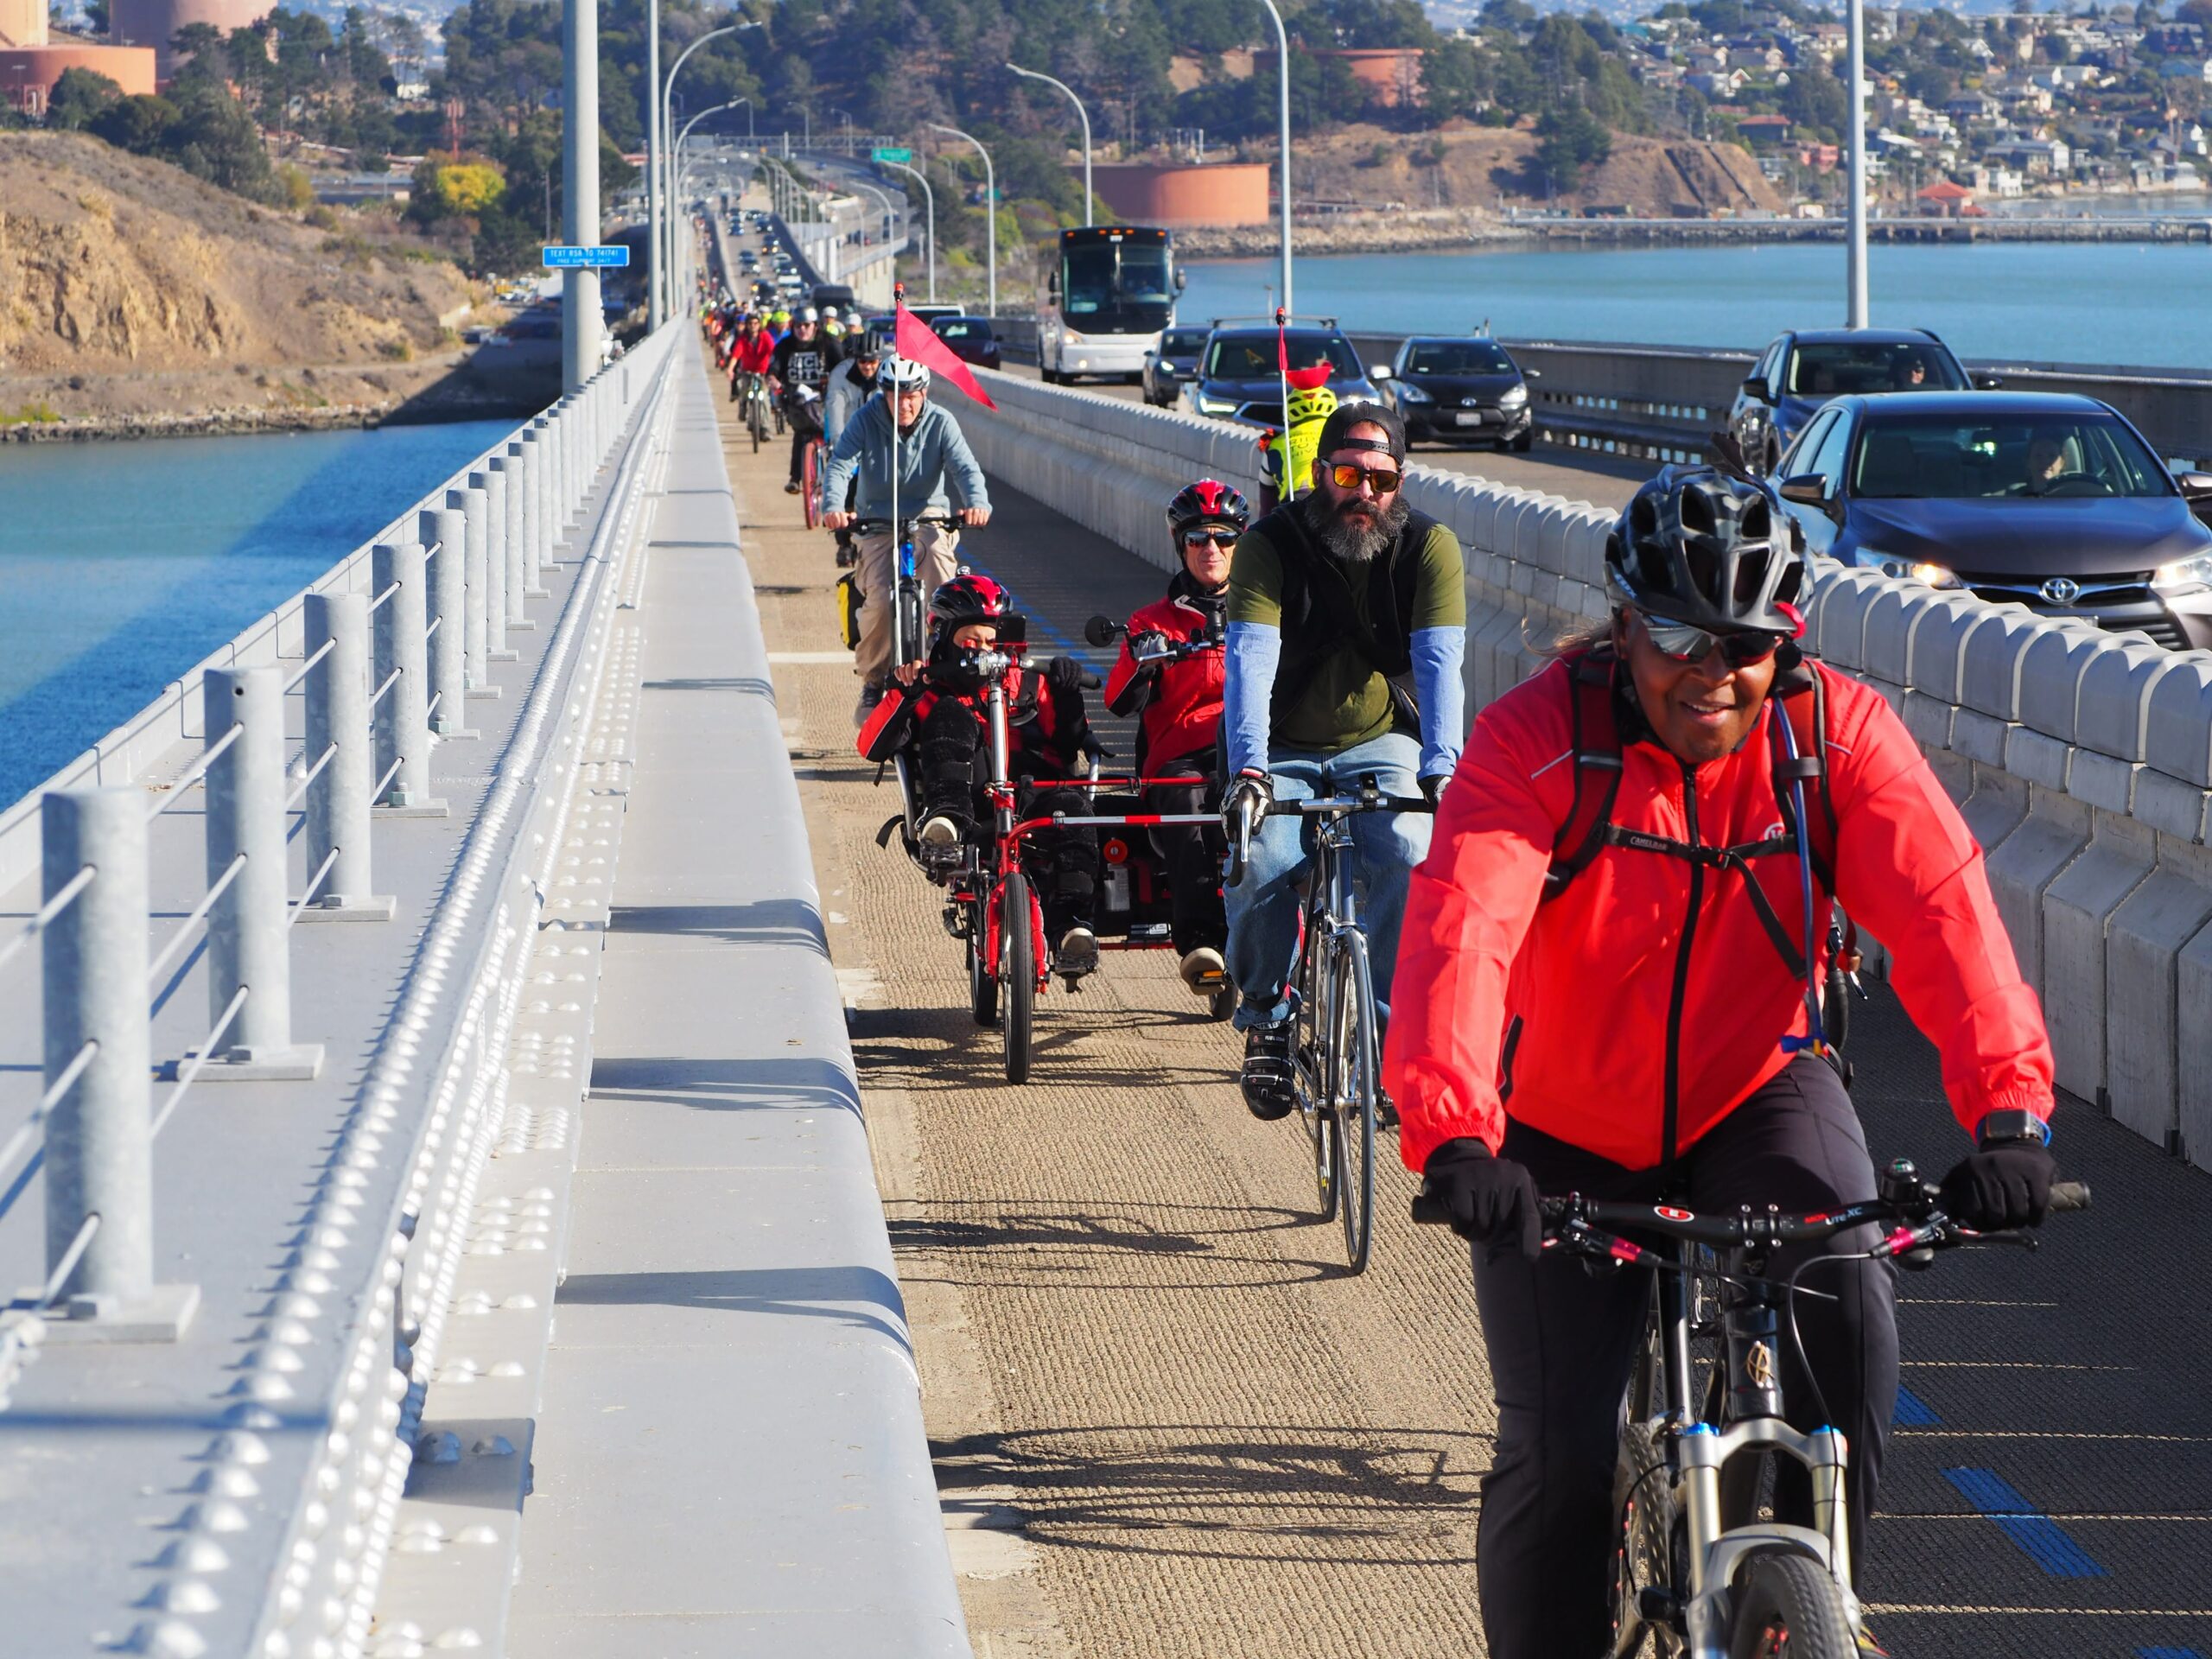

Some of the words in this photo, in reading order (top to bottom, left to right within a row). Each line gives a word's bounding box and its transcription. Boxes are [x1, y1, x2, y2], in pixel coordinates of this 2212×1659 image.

[550, 249, 566, 257] TEXT
[787, 368, 825, 380] CITY
[1847, 1206, 1862, 1217] XC
